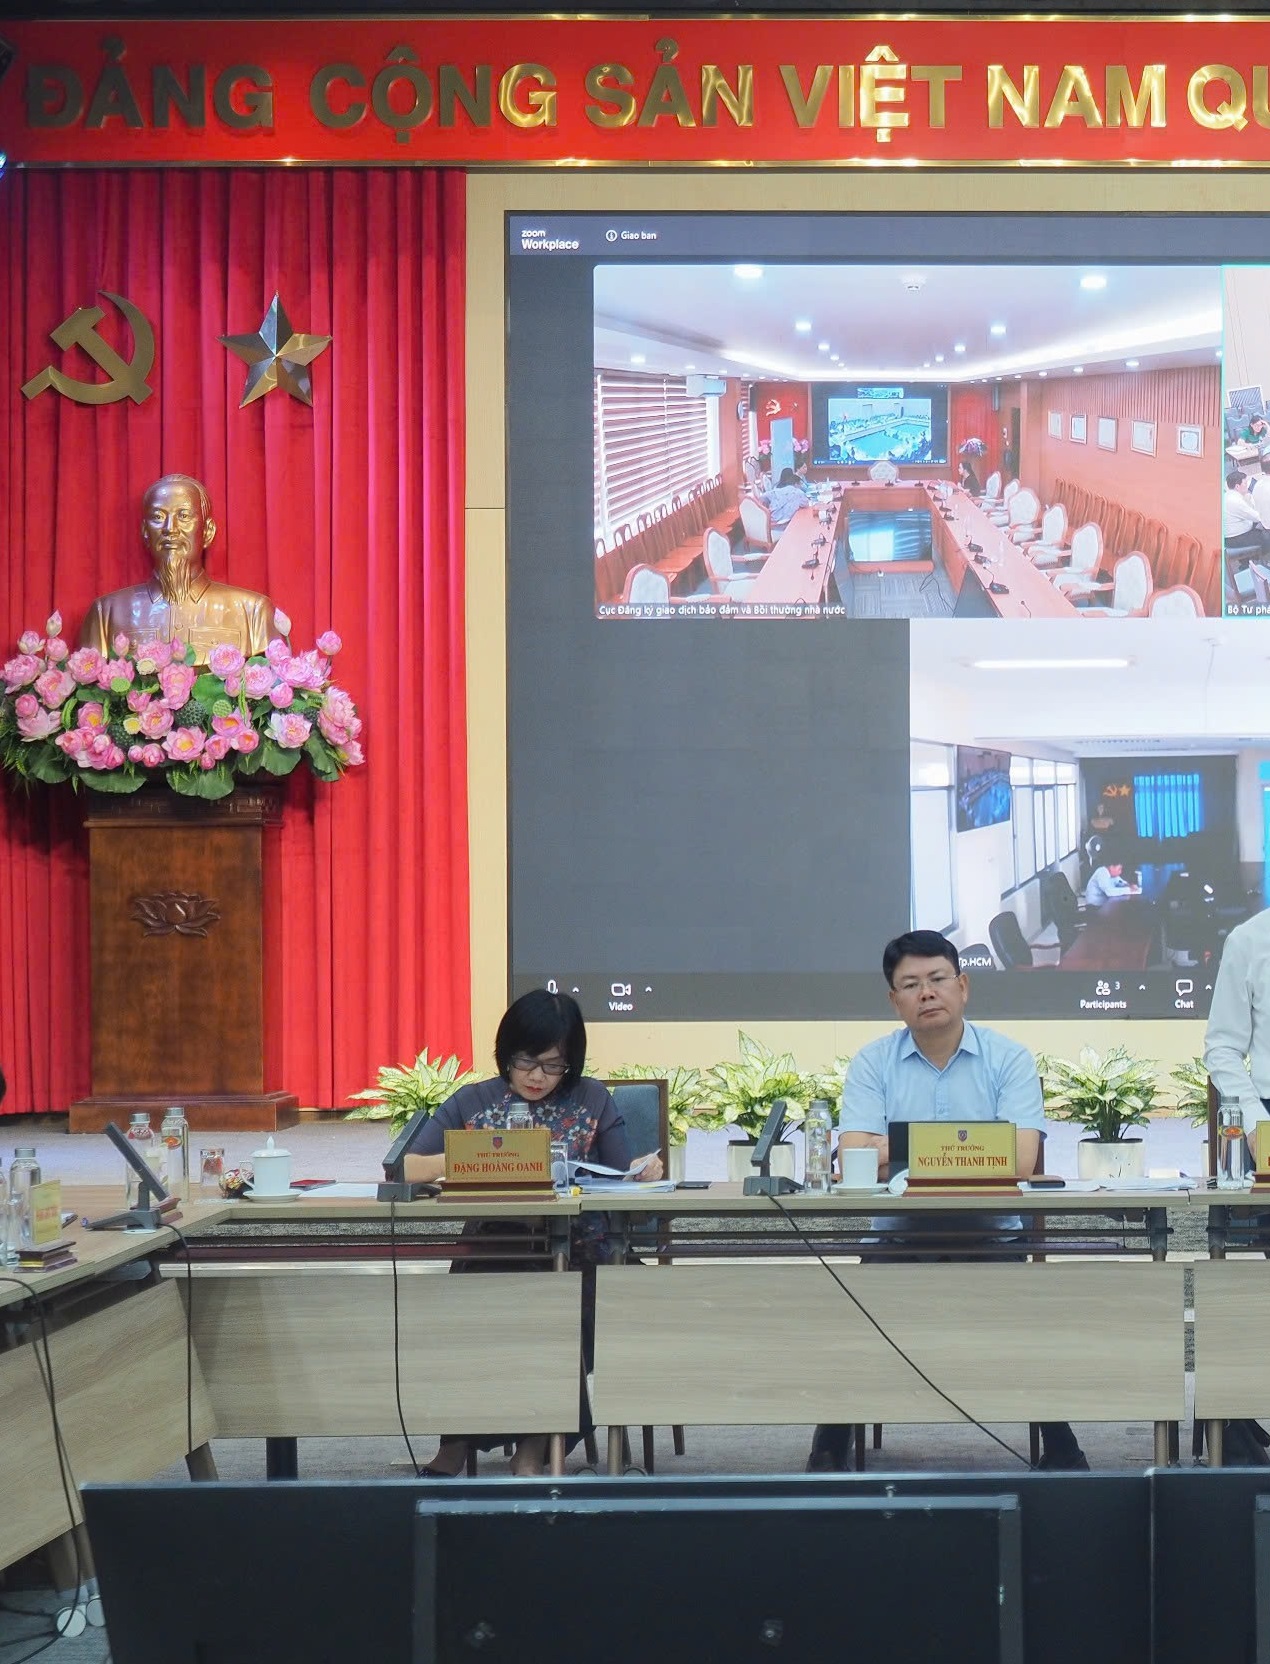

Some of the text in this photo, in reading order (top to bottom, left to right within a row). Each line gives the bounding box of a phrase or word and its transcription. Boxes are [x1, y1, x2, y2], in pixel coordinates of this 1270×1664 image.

[25, 37, 274, 131] ĐẢNG
[309, 46, 558, 143] CỘNG
[585, 37, 753, 128] SẢN
[778, 45, 963, 143] VIỆT
[987, 65, 1167, 130] NAM
[521, 229, 546, 238] zoom
[621, 231, 657, 240] Giao ban
[521, 238, 579, 251] Workplace
[599, 605, 615, 615] Cục
[643, 605, 653, 616] ký
[655, 607, 675, 617] giao
[678, 604, 696, 616] dịch
[699, 603, 716, 615] bảo
[719, 603, 738, 615] đảm
[741, 604, 752, 615] và
[804, 605, 820, 615] nhà
[823, 605, 845, 615] nước
[1227, 605, 1239, 615] Bộ
[1114, 981, 1121, 990] 3
[608, 1001, 634, 1011] Video
[1080, 999, 1127, 1011] Participants
[1174, 999, 1194, 1009] Chat
[516, 1162, 544, 1172] OANH
[955, 1156, 985, 1167] THANH
[987, 1156, 1008, 1170] TỊNH
